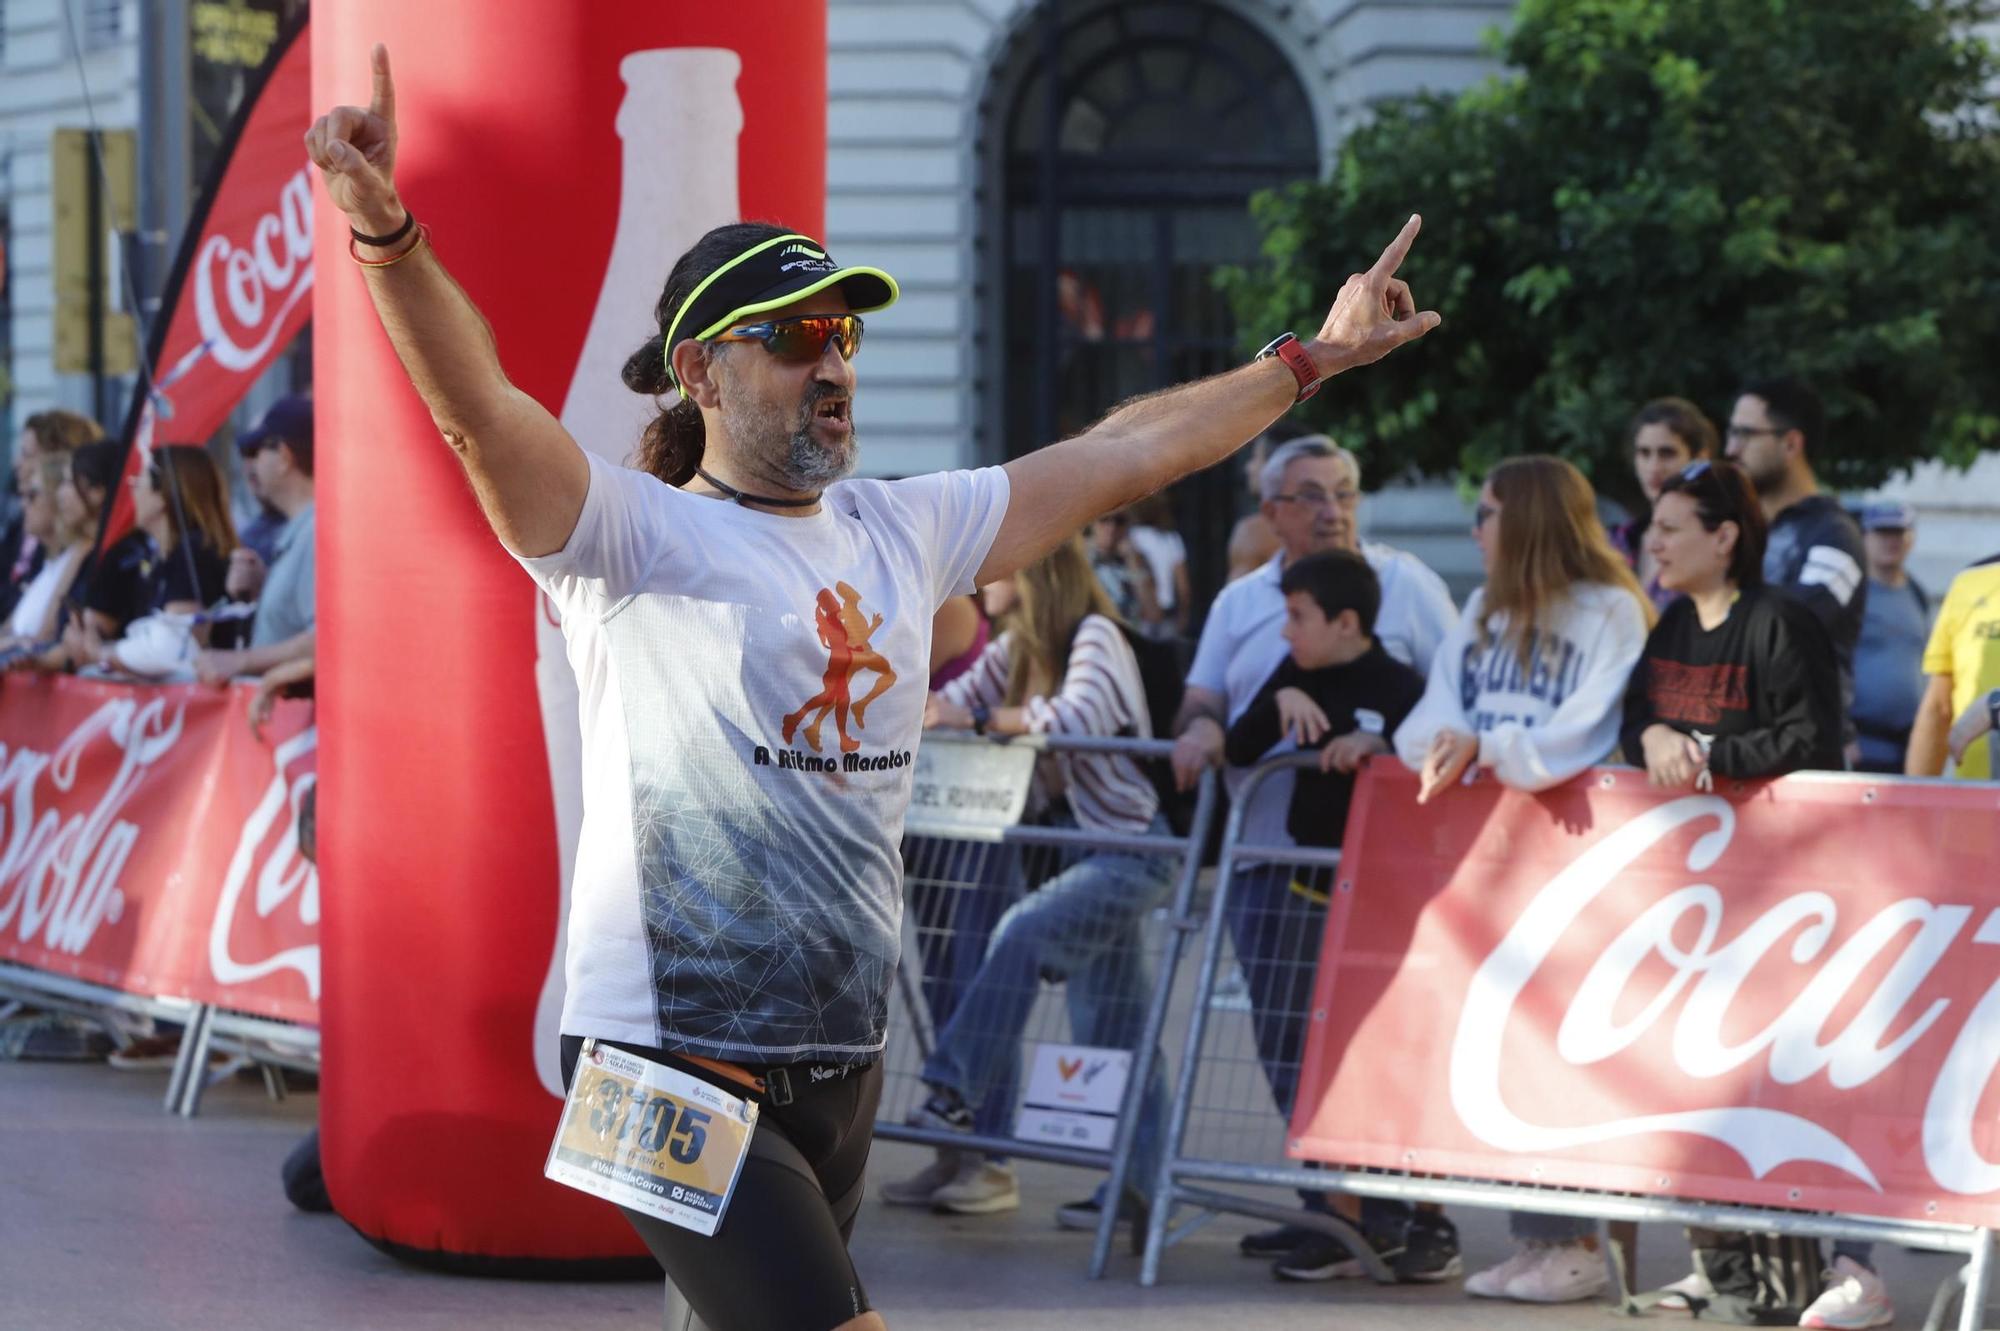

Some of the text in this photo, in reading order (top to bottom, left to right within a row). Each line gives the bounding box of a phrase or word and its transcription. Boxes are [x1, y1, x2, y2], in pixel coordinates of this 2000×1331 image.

[754, 745, 770, 766] A
[778, 748, 838, 773] Ritmo
[842, 747, 911, 773] Maratón
[1450, 794, 2000, 1195] Coca
[589, 1077, 713, 1165] 3705
[683, 1195, 714, 1211] popular
